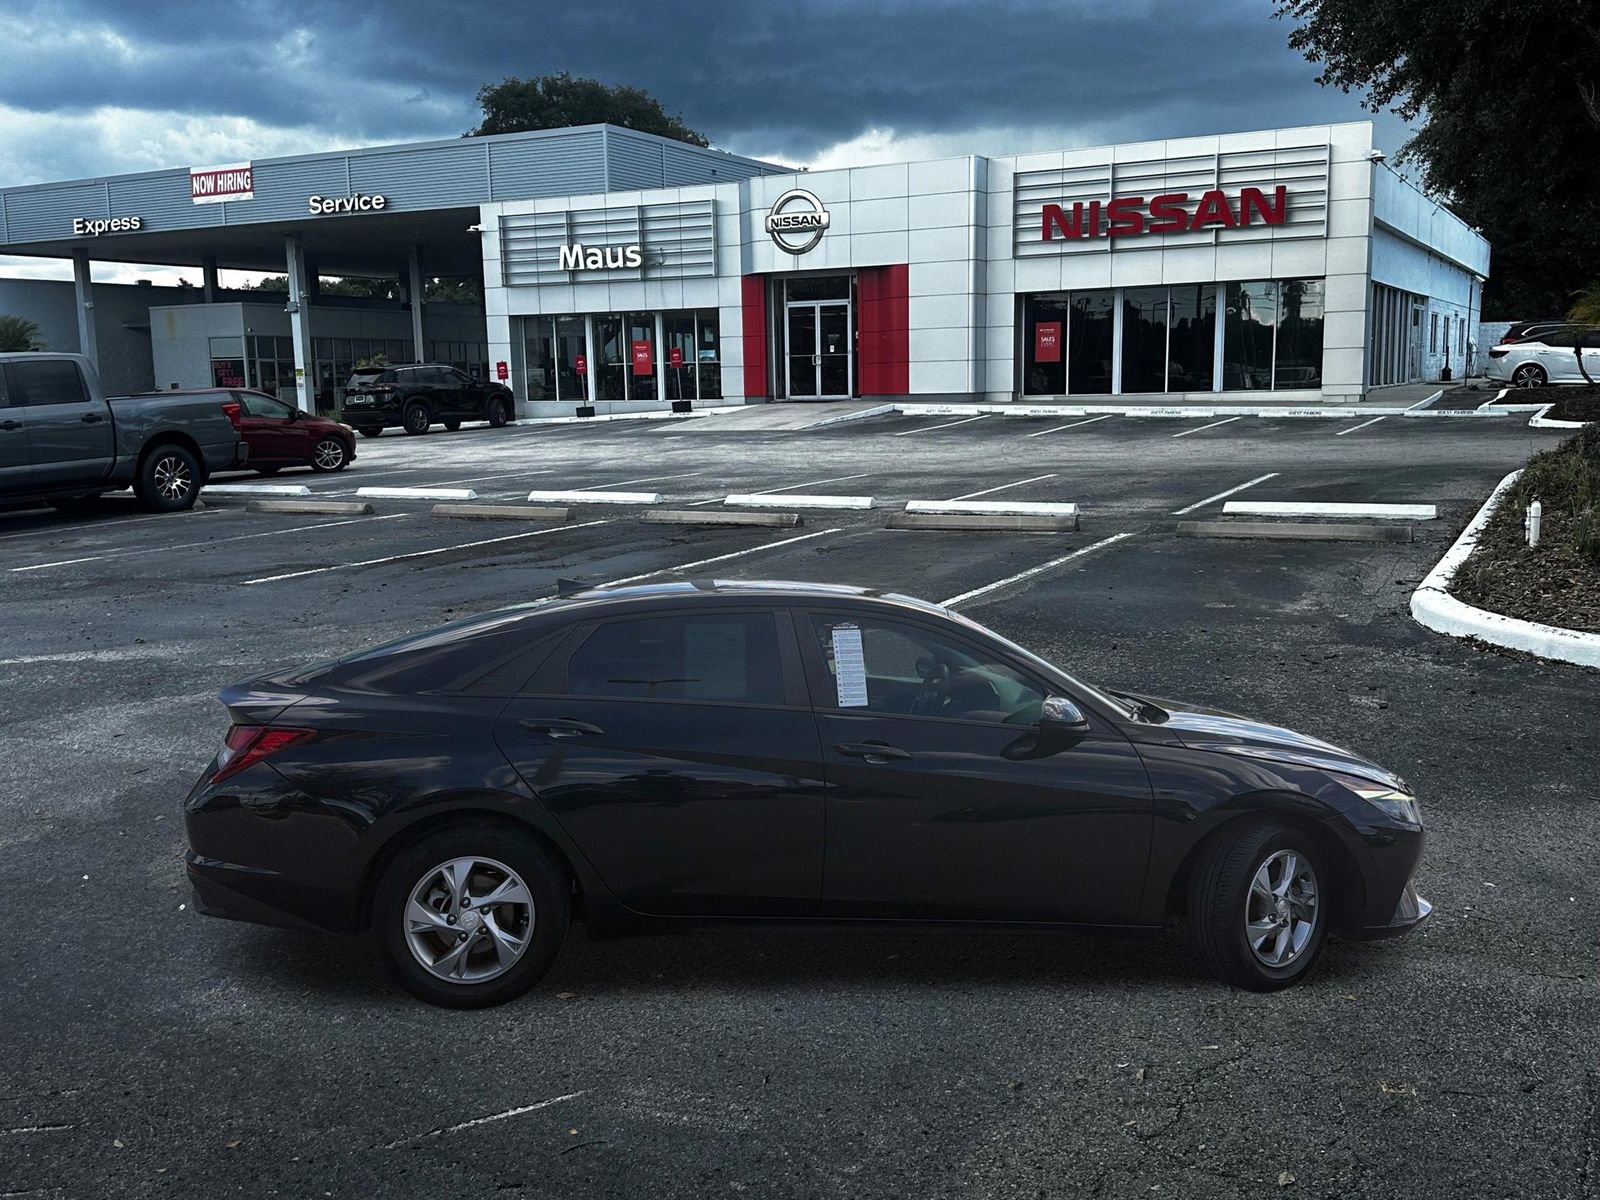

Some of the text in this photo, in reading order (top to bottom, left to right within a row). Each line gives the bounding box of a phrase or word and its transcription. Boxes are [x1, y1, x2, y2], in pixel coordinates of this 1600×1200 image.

[192, 171, 251, 194] NOW HIRING
[309, 193, 385, 215] Service
[1042, 185, 1286, 241] NISSAN
[73, 216, 140, 236] Express
[770, 215, 822, 228] NISSAN
[560, 243, 642, 270] Maus
[223, 377, 244, 387] FREE
